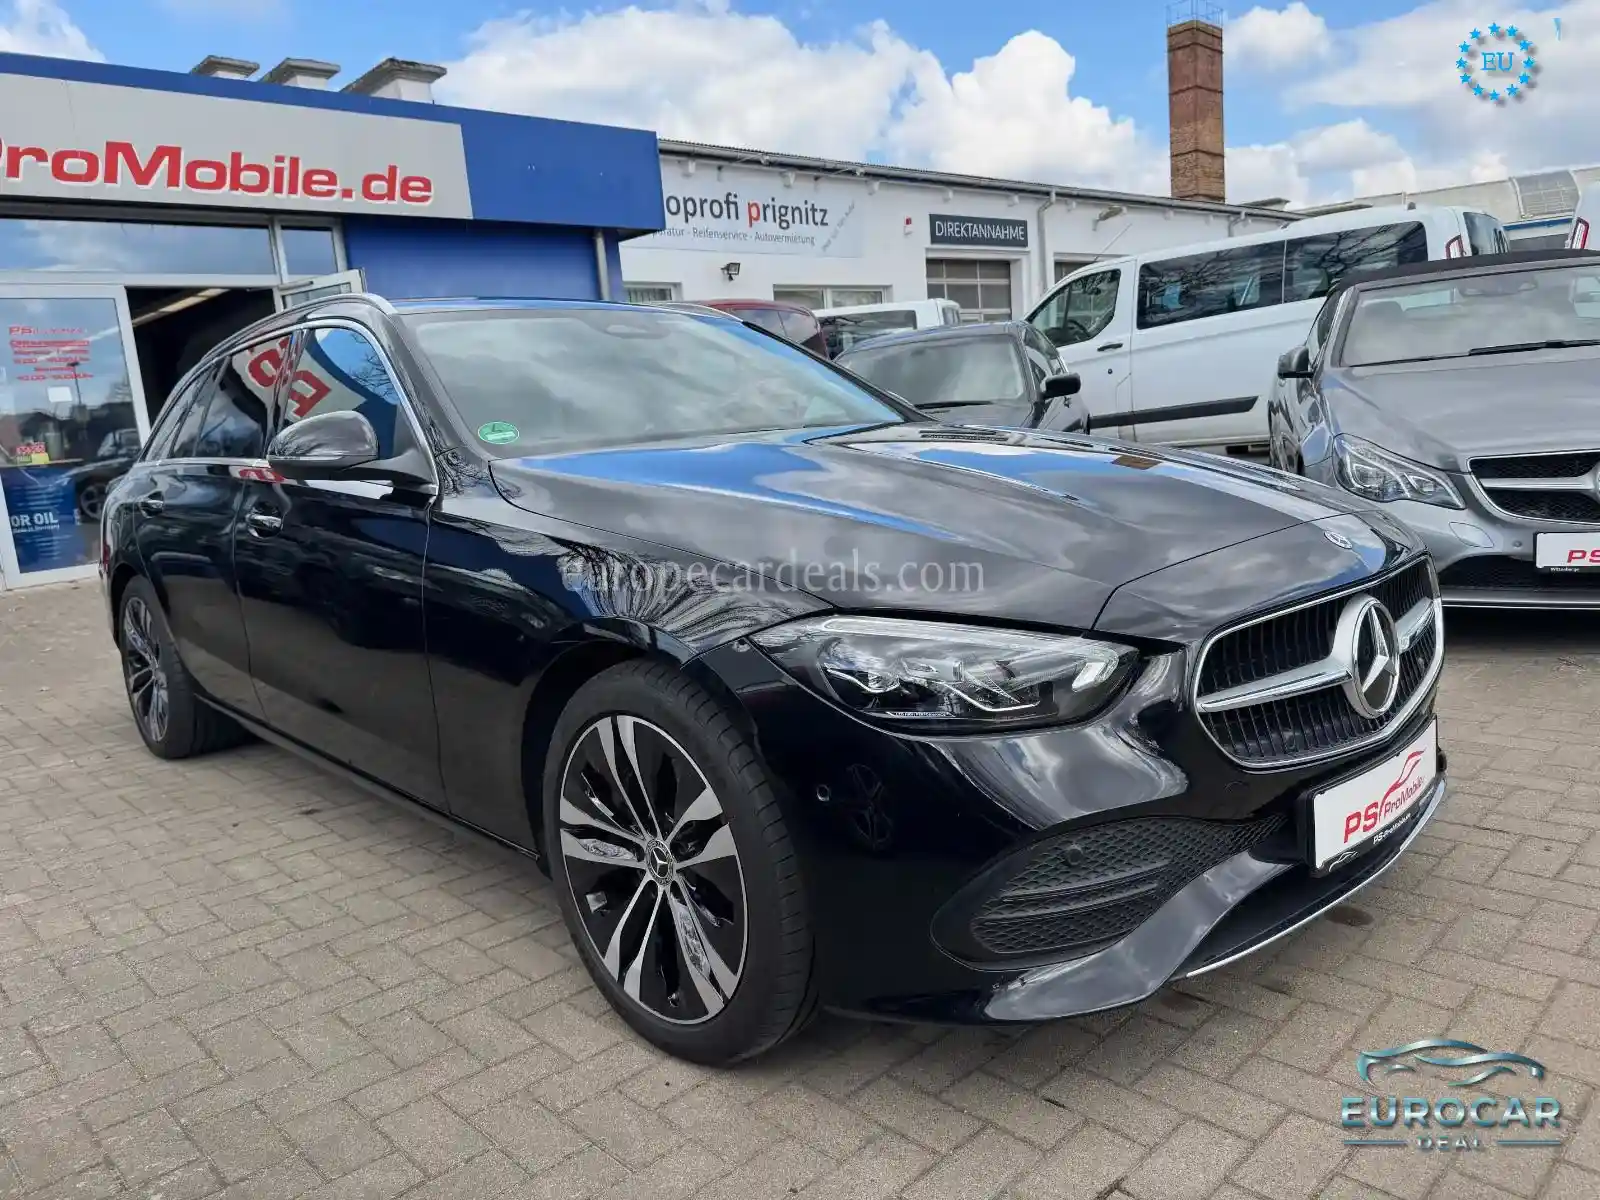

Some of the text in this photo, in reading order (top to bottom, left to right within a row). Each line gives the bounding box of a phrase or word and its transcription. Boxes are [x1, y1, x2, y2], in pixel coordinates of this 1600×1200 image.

[0, 138, 433, 204] roMobile.de
[665, 192, 740, 224] oprofi
[747, 196, 830, 231] prignitz
[692, 226, 749, 242] Reifenservice
[754, 231, 817, 247] Autovermietung
[935, 220, 1025, 240] DIREKTANNAHME
[10, 514, 32, 528] OR
[33, 511, 59, 526] OIL
[1343, 801, 1379, 844] PS
